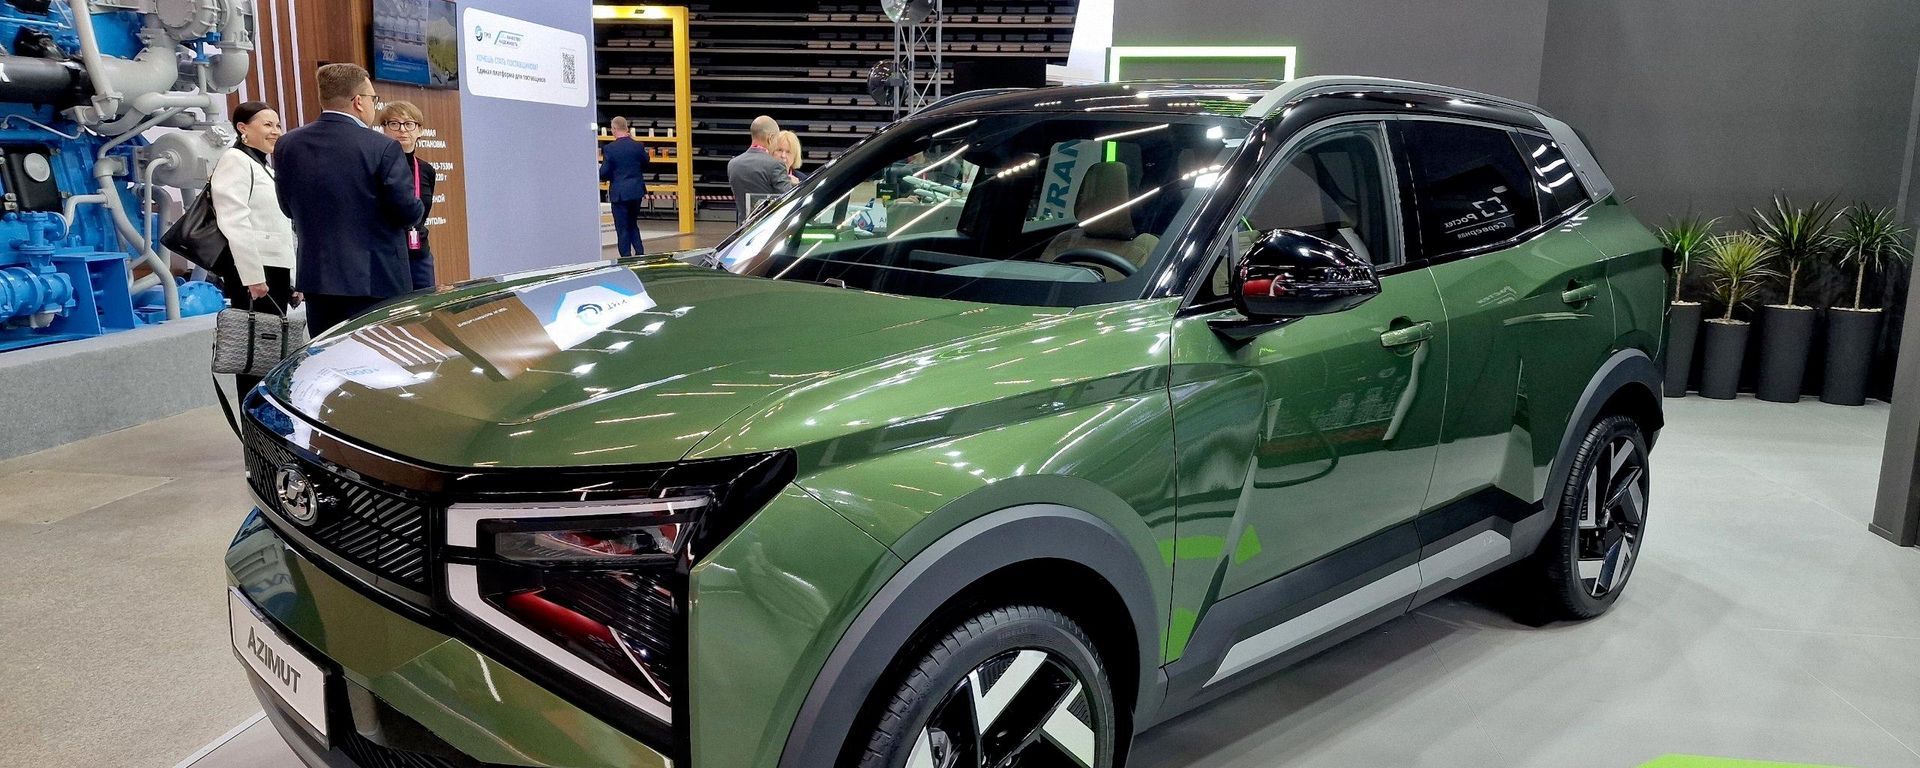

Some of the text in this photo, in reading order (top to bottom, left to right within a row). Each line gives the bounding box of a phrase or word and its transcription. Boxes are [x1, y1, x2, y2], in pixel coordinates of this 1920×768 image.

[476, 66, 492, 75] Единая
[493, 70, 515, 79] платформа
[247, 625, 301, 694] AZIMUT
